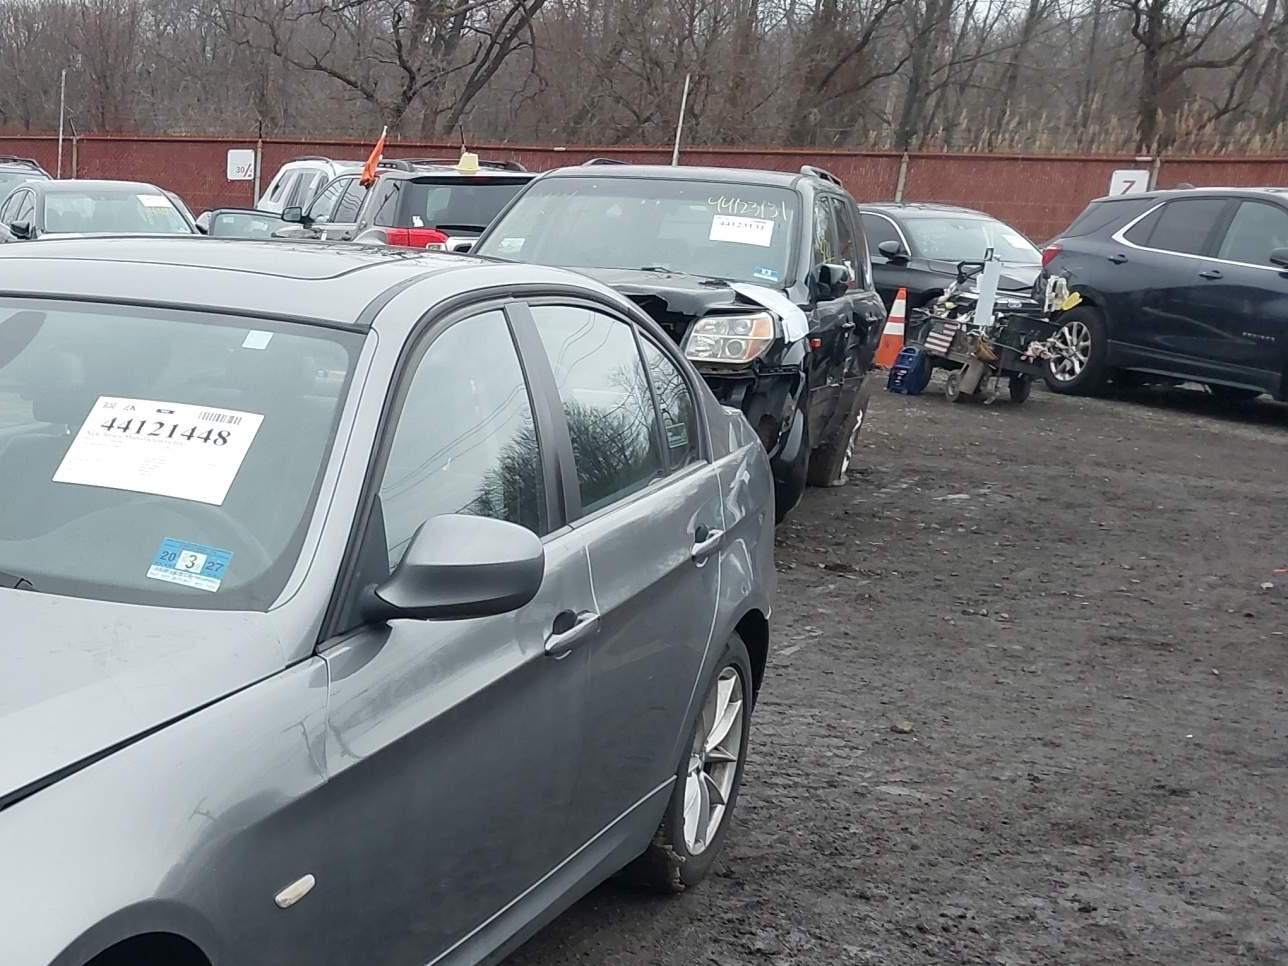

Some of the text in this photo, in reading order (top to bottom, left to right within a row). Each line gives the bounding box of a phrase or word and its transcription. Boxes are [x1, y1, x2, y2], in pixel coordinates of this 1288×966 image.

[1120, 180, 1137, 195] 7
[708, 195, 787, 221] 44123131
[100, 417, 231, 447] 44121448
[159, 550, 225, 573] 20 3 27
